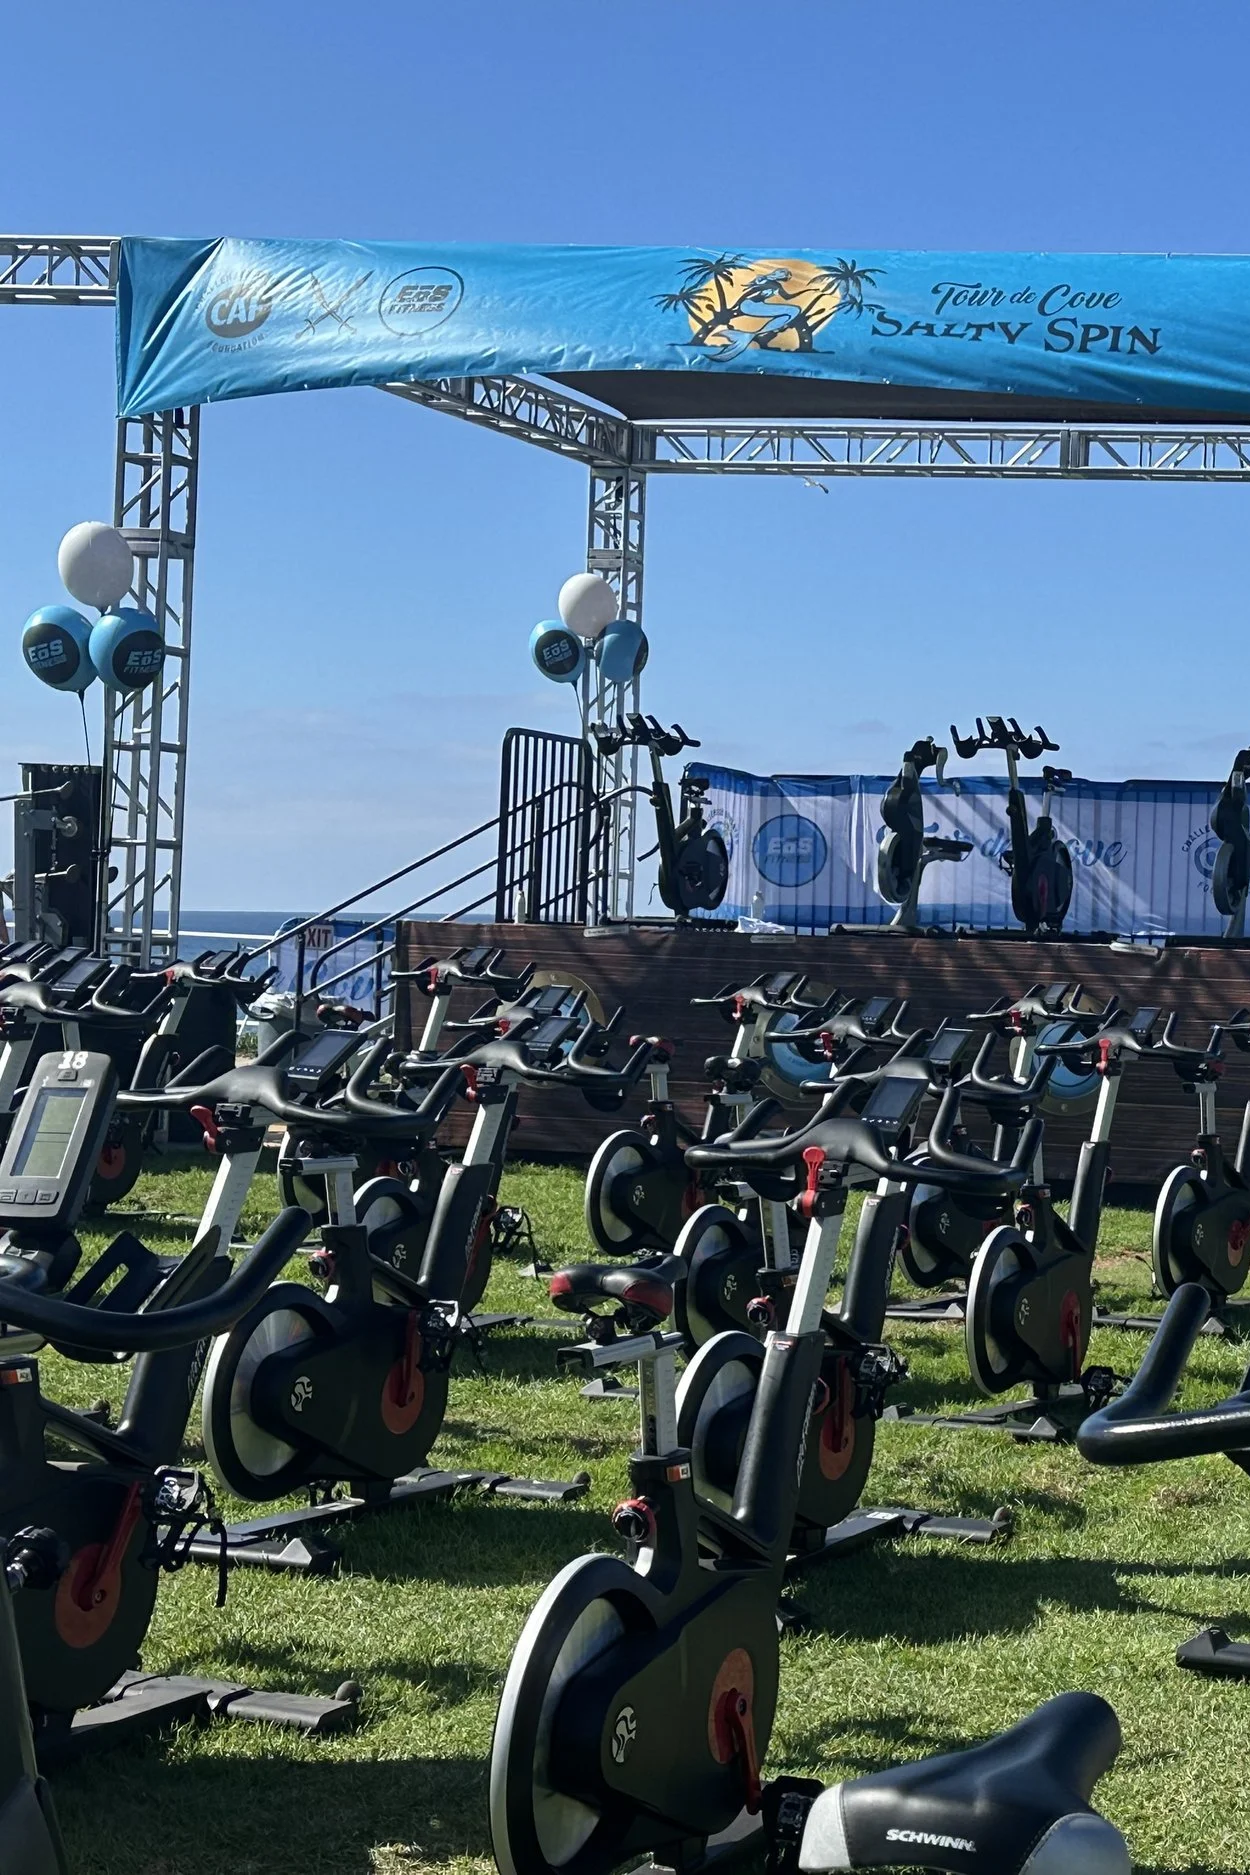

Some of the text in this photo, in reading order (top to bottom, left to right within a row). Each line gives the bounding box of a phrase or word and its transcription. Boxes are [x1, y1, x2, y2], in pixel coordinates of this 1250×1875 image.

[931, 281, 1122, 317] Tour de Cove
[871, 310, 1163, 356] SALTY SPIN
[306, 927, 331, 949] XIT
[57, 1050, 88, 1070] 18
[885, 1828, 977, 1852] SCHWINN
